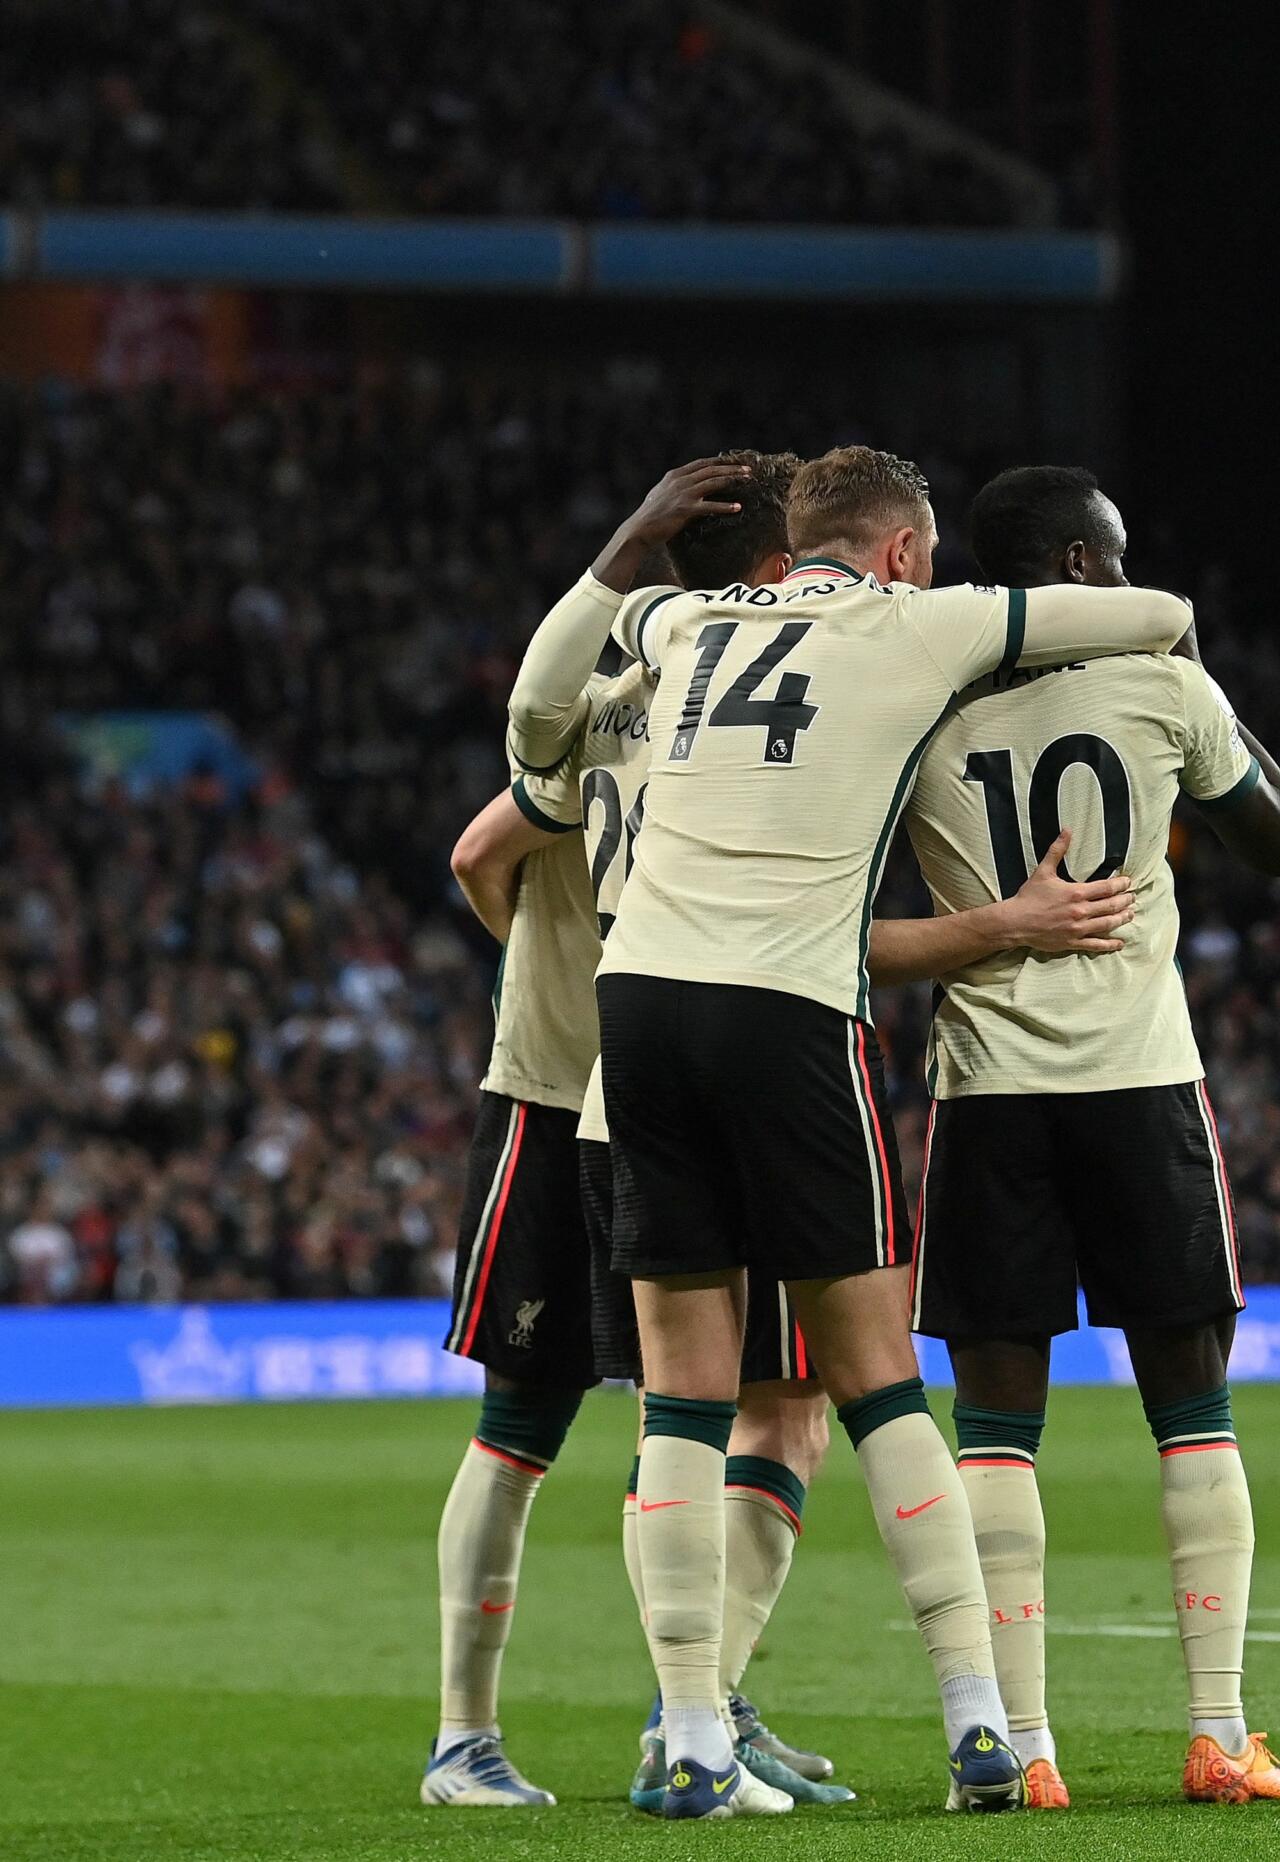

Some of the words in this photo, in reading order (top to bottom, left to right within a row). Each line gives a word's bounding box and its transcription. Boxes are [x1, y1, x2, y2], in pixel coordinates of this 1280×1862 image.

[592, 700, 650, 742] DIOG
[667, 621, 820, 764] 14
[962, 732, 1132, 901] 10
[1175, 1592, 1222, 1612] FC
